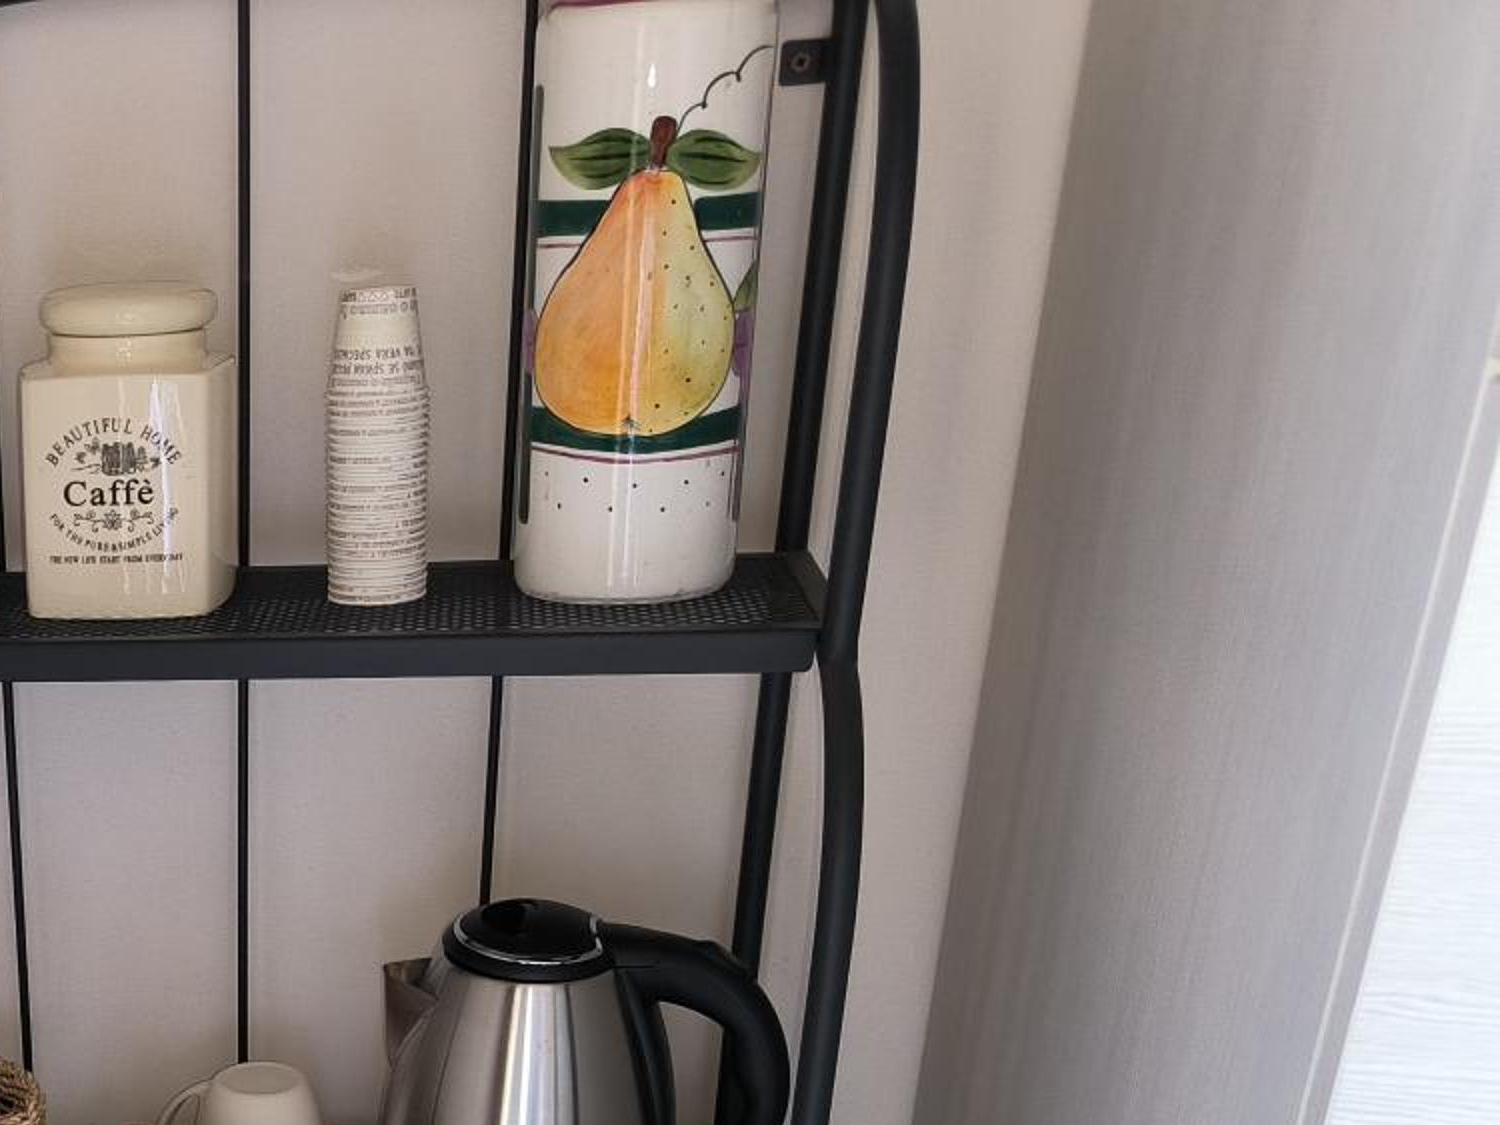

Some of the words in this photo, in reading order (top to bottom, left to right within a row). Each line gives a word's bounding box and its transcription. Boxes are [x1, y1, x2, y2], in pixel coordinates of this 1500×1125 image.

[45, 417, 134, 468] BEAUTIFUL
[139, 423, 182, 465] HOME
[63, 479, 155, 507] Caffè
